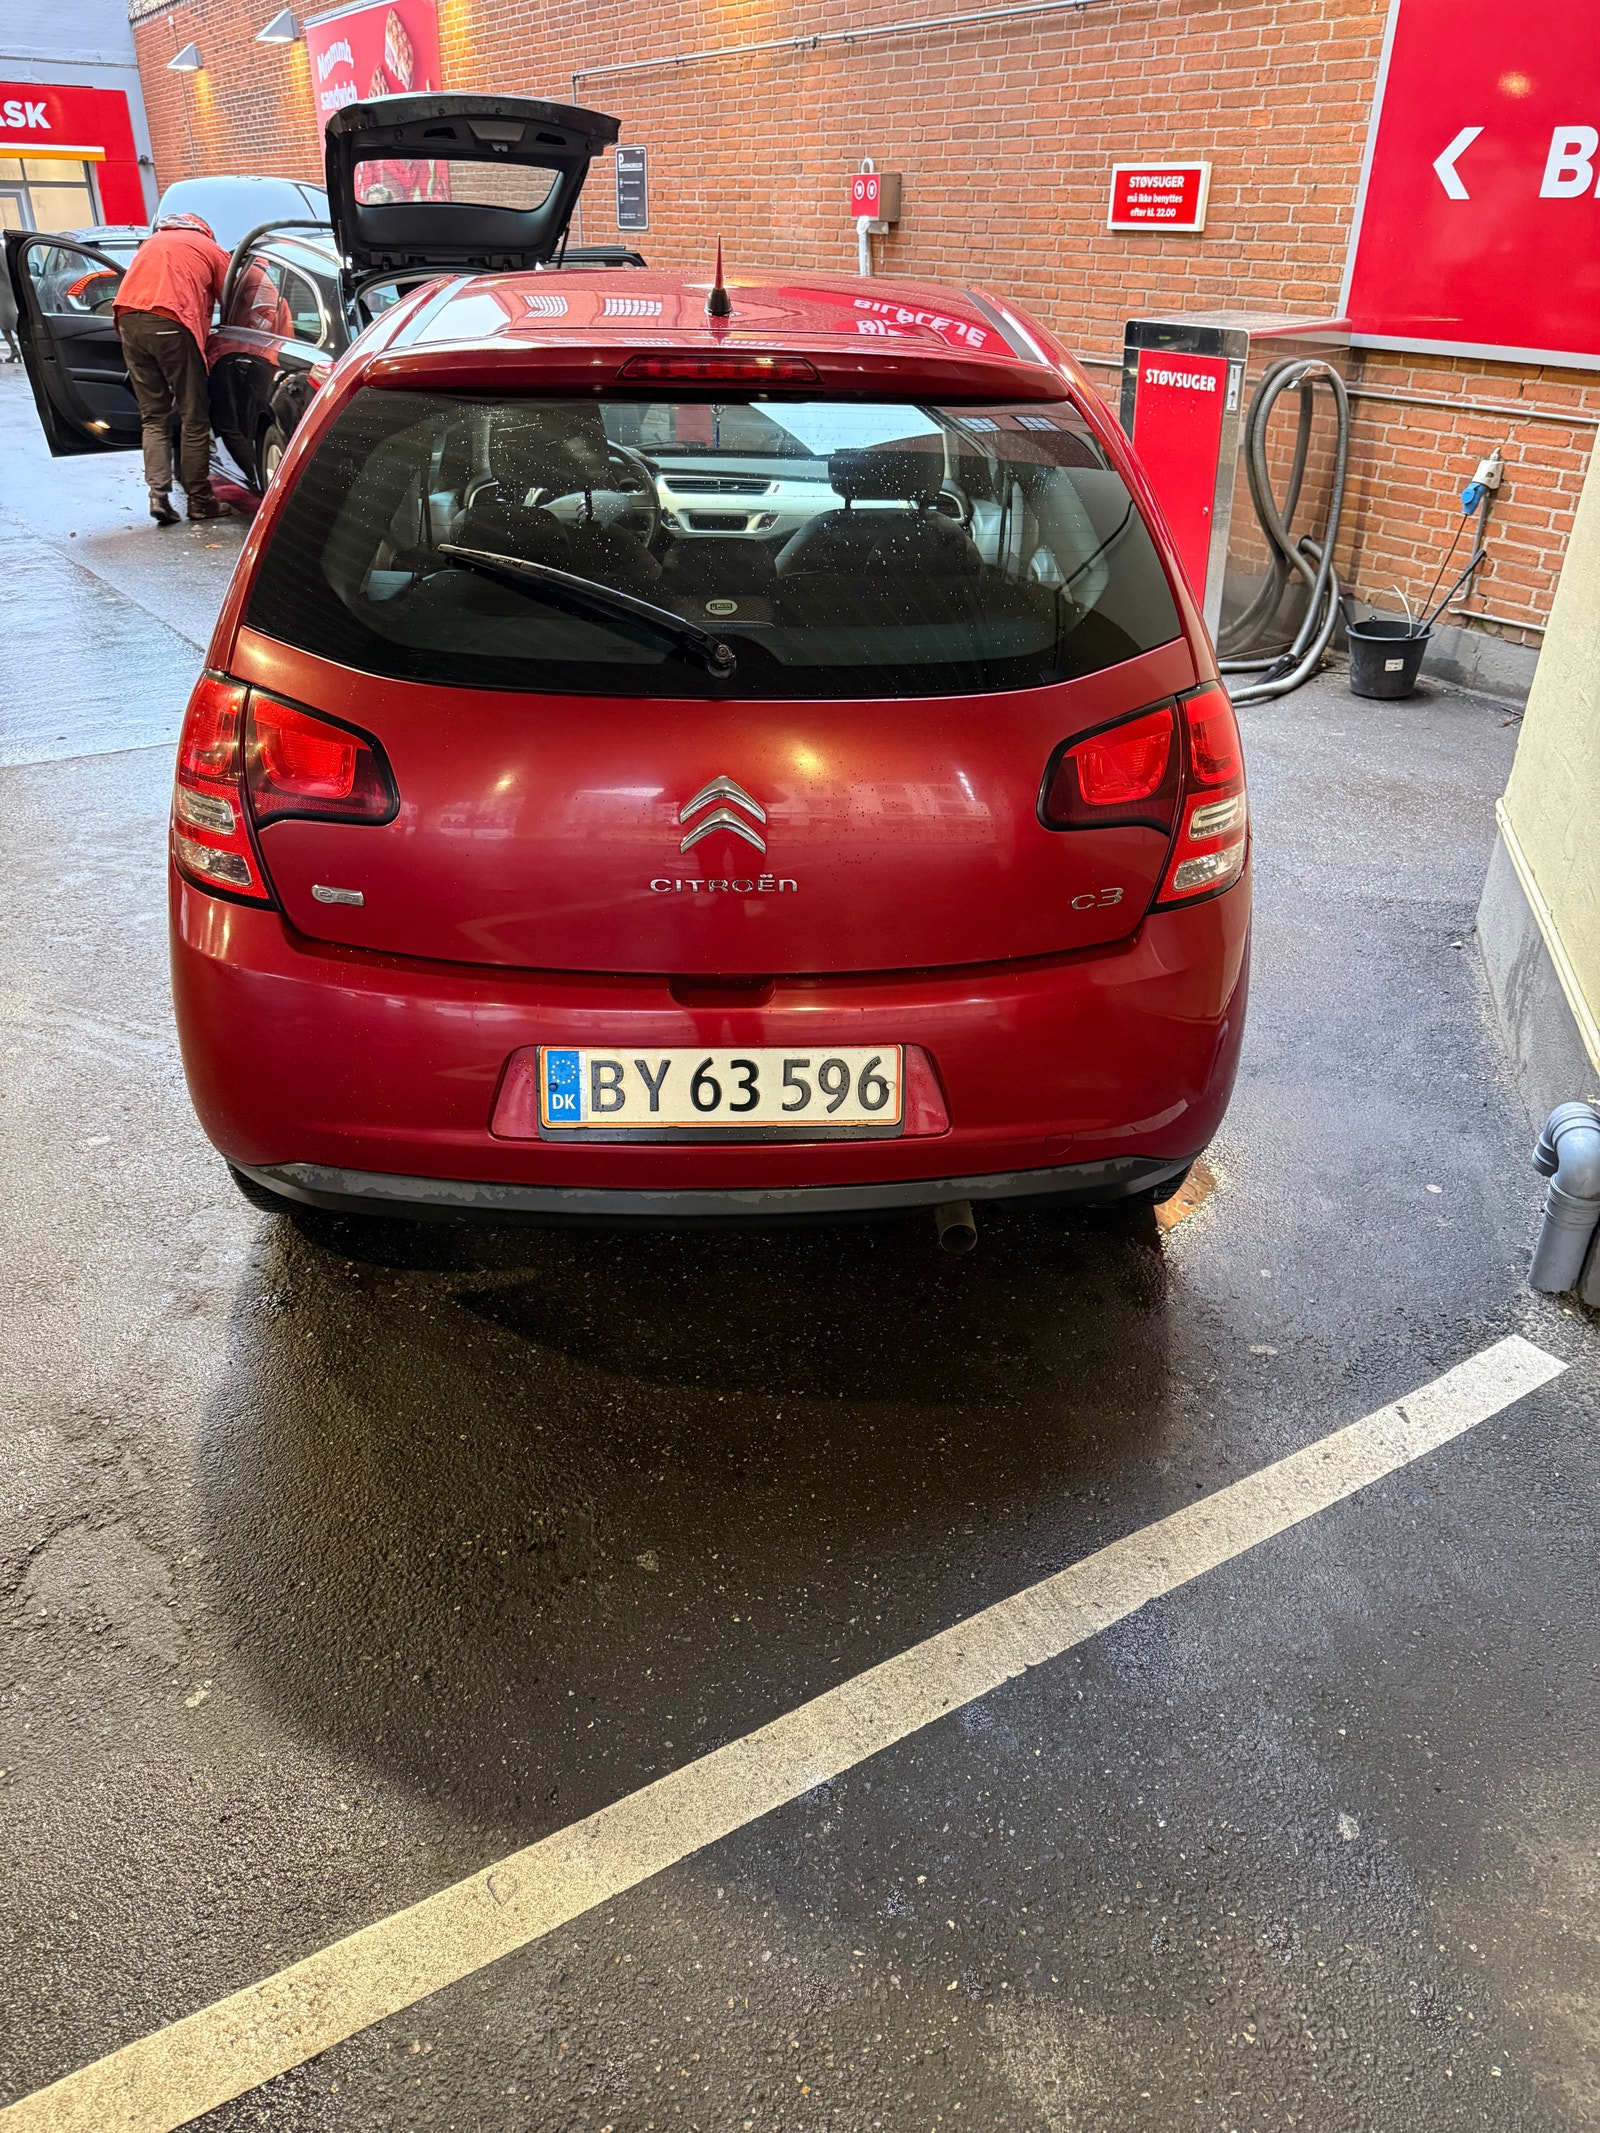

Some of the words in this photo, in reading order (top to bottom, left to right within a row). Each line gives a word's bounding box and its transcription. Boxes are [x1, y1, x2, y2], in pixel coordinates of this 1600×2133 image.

[321, 80, 358, 111] sandwich
[0, 100, 52, 129] SK
[1539, 125, 1600, 198] B
[1129, 175, 1185, 188] STØVSUGER
[1127, 193, 1138, 203] må
[1138, 194, 1152, 203] ikke
[1153, 194, 1183, 204] benyttes
[1130, 207, 1146, 217] efter
[1156, 208, 1176, 217] 22.00
[1145, 368, 1216, 392] STØVSUGER
[1071, 887, 1124, 910] C3
[590, 1059, 671, 1112] BY
[690, 1056, 760, 1112] 63
[781, 1055, 890, 1113] 596
[552, 1093, 576, 1110] DK
